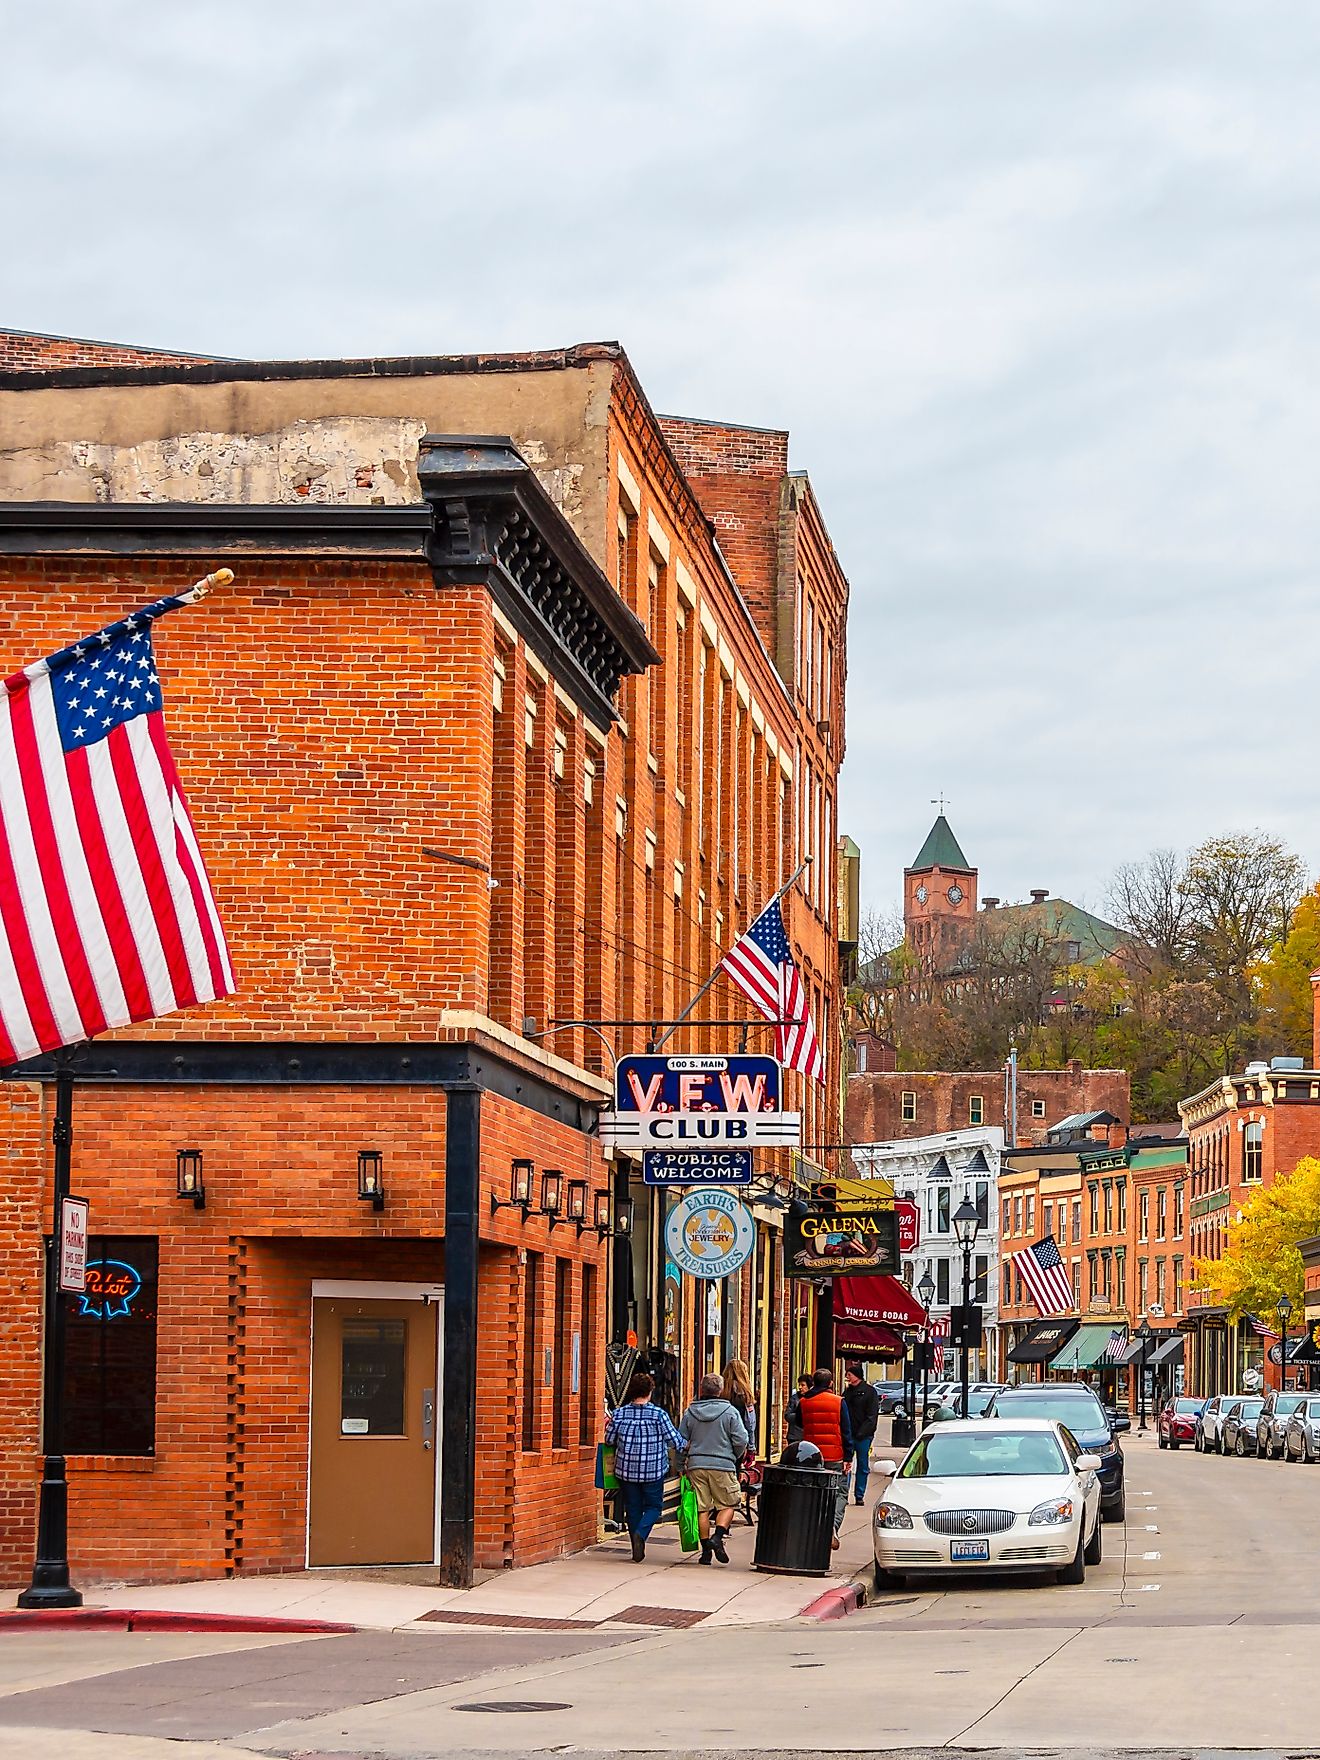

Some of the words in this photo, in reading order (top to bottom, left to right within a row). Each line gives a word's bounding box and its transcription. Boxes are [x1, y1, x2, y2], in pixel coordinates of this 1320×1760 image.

[649, 1119, 748, 1139] CLUB
[665, 1154, 731, 1165] PUBLIC
[652, 1167, 744, 1179] WELCOME
[685, 1194, 737, 1212] EARTH'S
[71, 1212, 80, 1229] NO
[800, 1216, 881, 1238] GALENA
[65, 1230, 84, 1249] PARKING
[688, 1234, 730, 1242] JEWELRY
[675, 1247, 744, 1275] TREASURES
[845, 1257, 877, 1266] COMPANY
[845, 1307, 879, 1319] VINTAGE
[882, 1310, 909, 1321] SODAS
